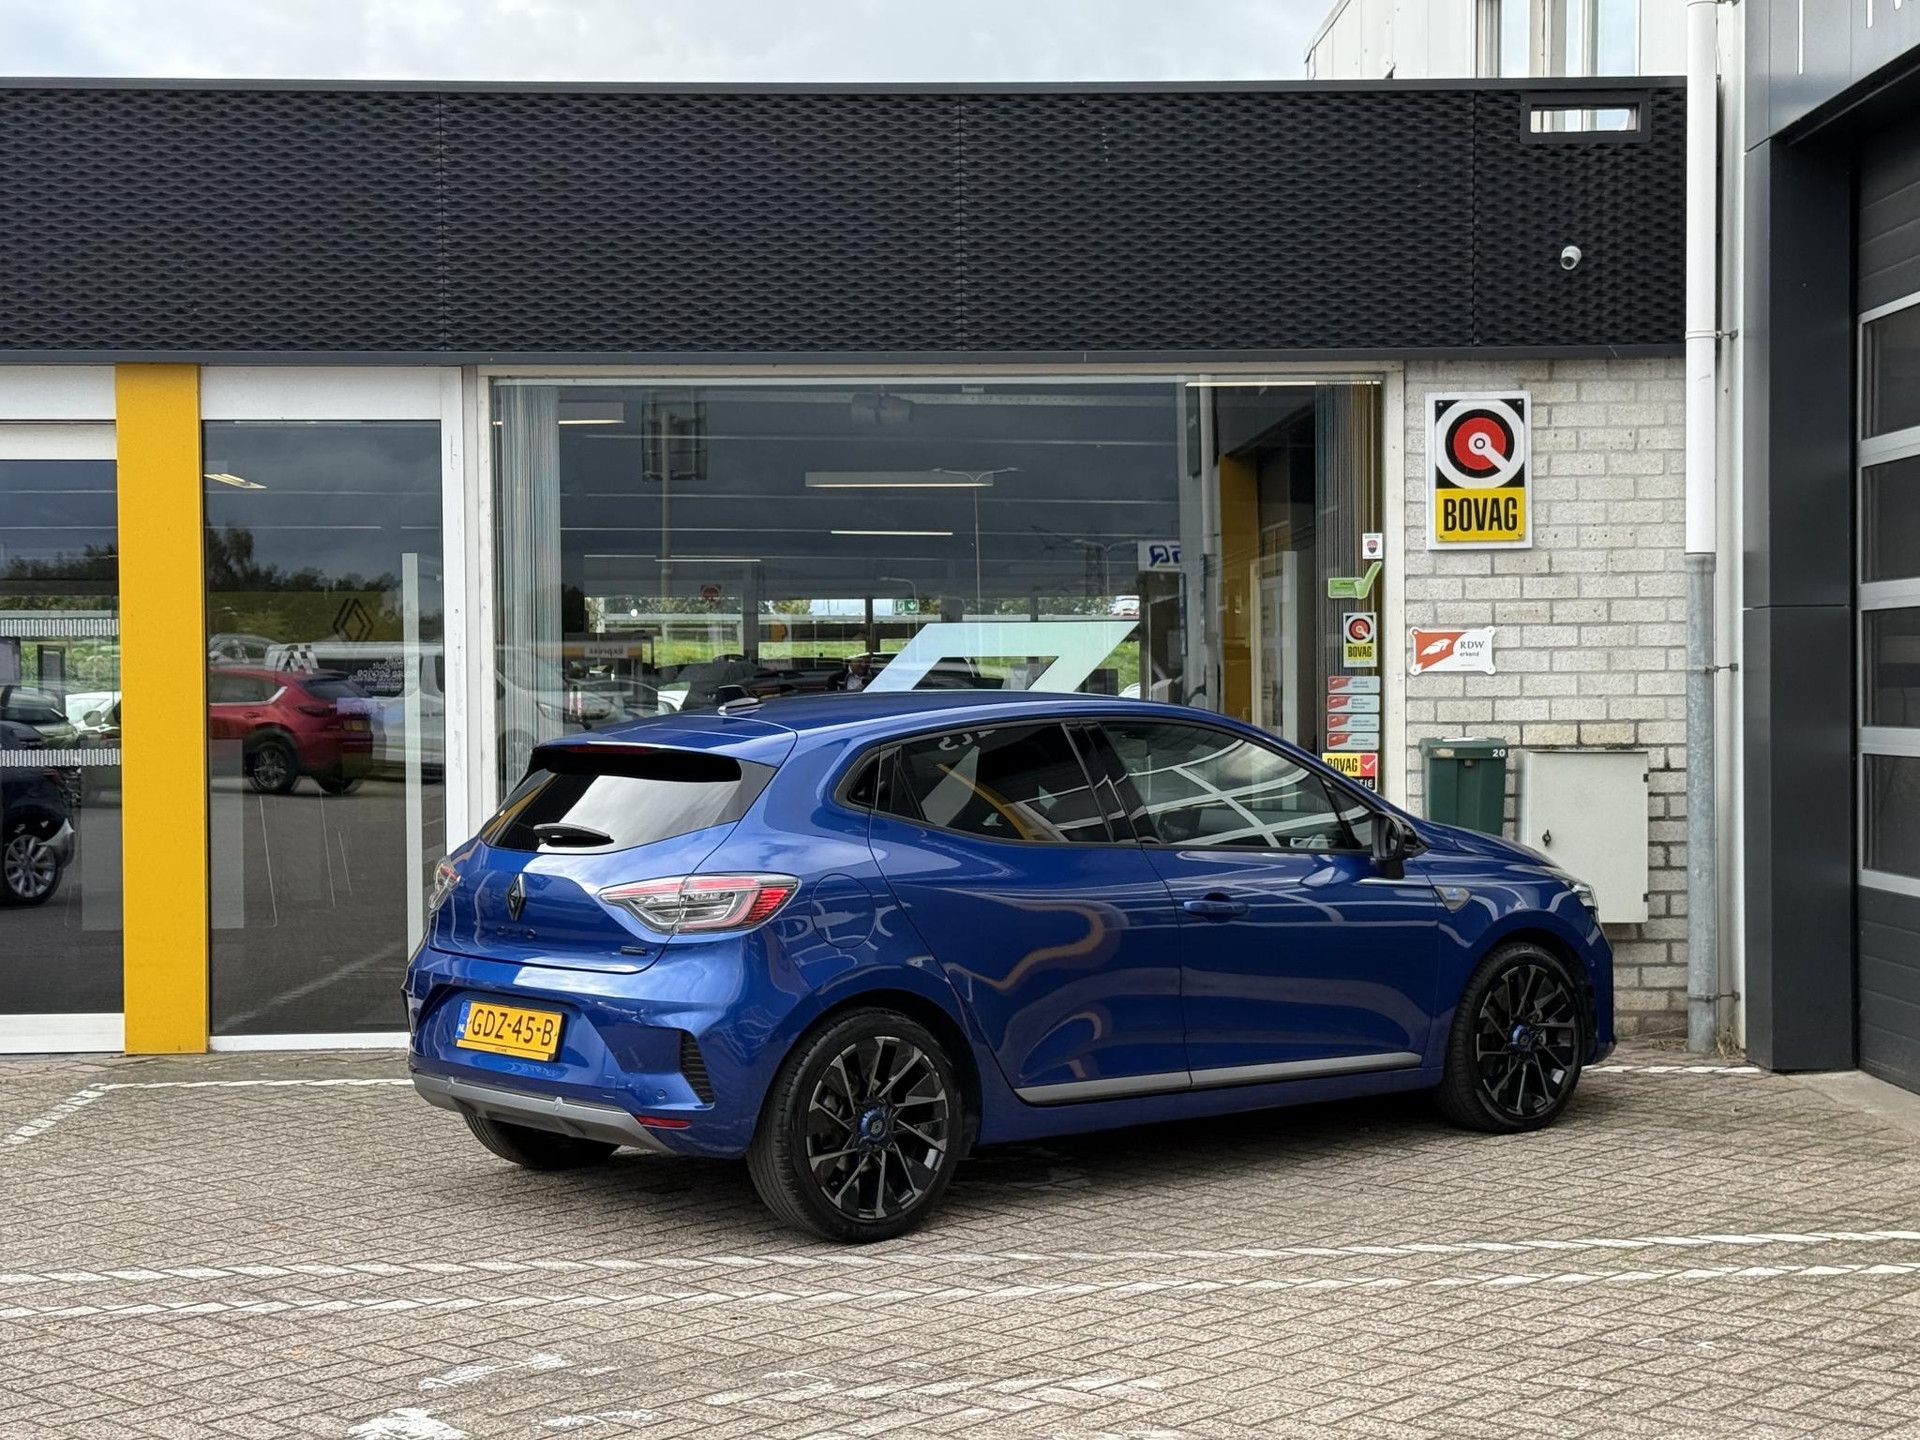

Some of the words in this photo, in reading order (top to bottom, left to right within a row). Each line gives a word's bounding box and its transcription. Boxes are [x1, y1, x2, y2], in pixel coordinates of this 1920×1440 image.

[1443, 497, 1518, 532] BOVAG
[1460, 640, 1485, 650] RDW
[1348, 646, 1372, 657] BOVAG
[1492, 748, 1506, 758] 20
[472, 1008, 554, 1046] GDZ-45-B
